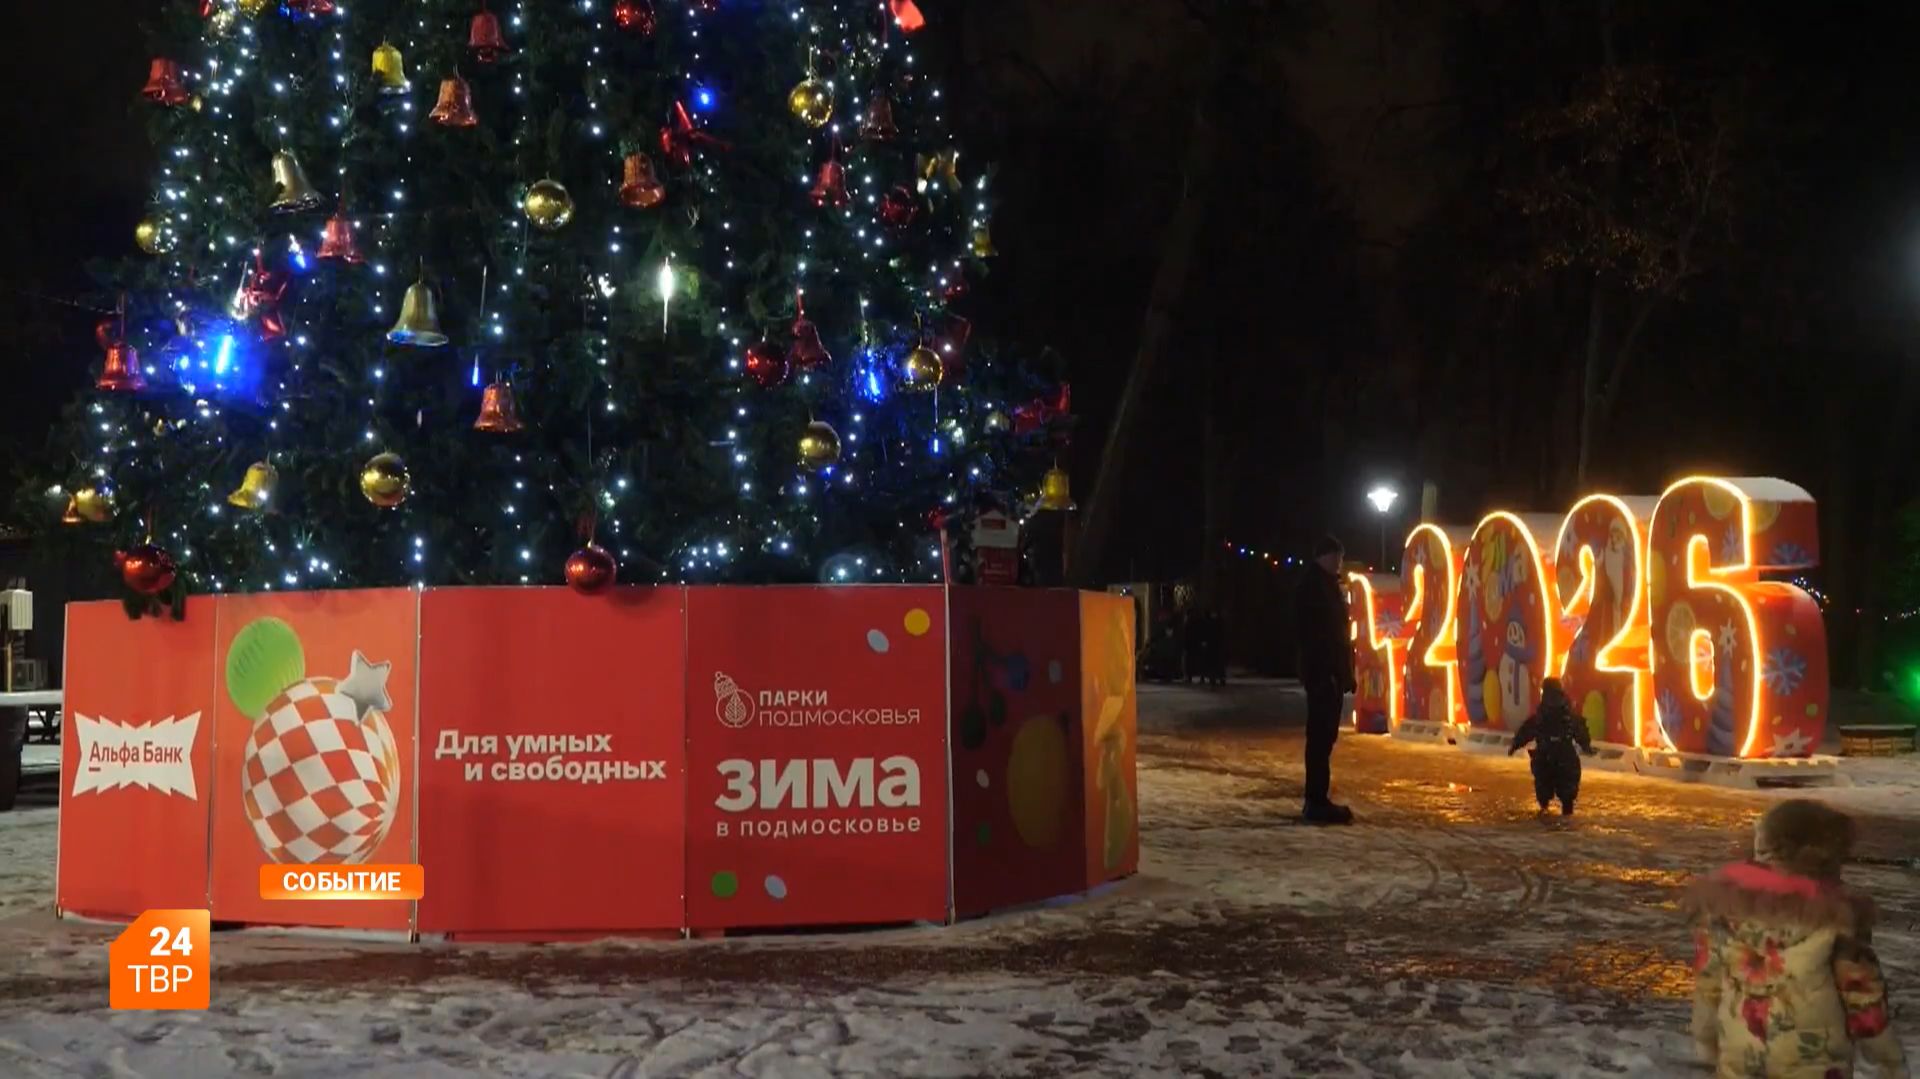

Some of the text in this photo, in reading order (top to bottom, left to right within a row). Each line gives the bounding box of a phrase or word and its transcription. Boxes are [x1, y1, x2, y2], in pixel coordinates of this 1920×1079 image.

[1402, 475, 1764, 758] 2026
[759, 690, 828, 707] ПАРКИ
[759, 708, 920, 728] ПОДМОСКОВЬЯ
[88, 740, 183, 772] Альфа Банк
[435, 729, 613, 760] Для умных
[465, 757, 667, 784] и свободных
[714, 756, 921, 812] зима
[717, 816, 921, 838] в подмосковье
